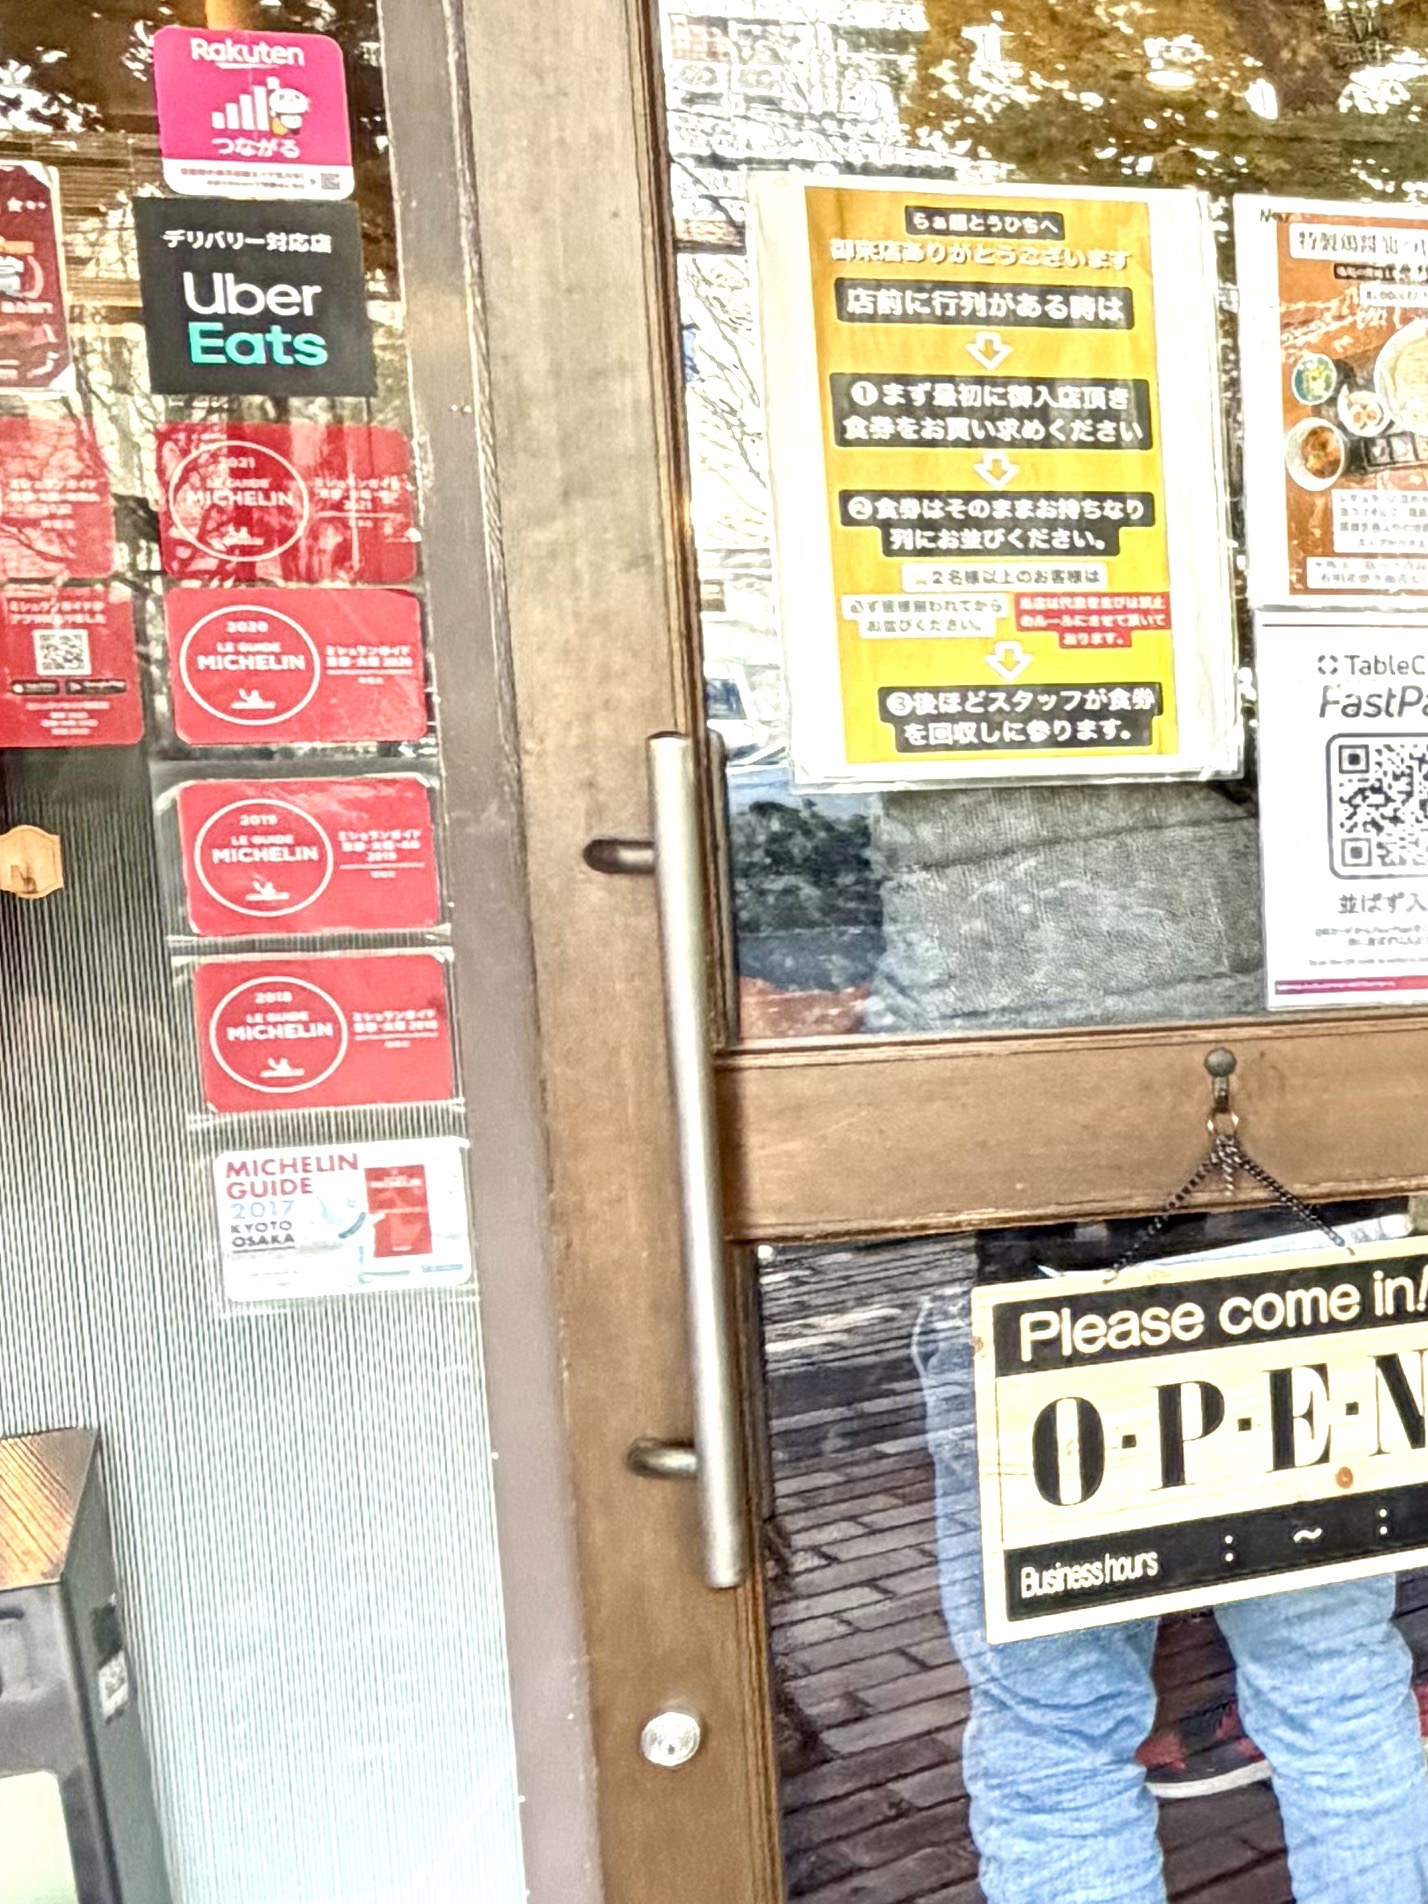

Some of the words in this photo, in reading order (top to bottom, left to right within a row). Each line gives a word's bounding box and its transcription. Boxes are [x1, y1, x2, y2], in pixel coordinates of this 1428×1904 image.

[190, 37, 305, 67] Rakuten
[211, 137, 300, 159] つながる
[162, 228, 332, 254] デリバリー対応店
[183, 271, 322, 317] Uber
[846, 286, 1125, 322] 店前に行列がある時は
[188, 322, 329, 367] Eats
[842, 415, 1145, 442] 食券をお買い求めください
[186, 489, 295, 507] MICHELIN
[889, 525, 1107, 551] 列にお並びください。
[196, 653, 306, 671] MICHELIN
[904, 720, 1132, 746] を回収しに参ります。
[212, 845, 319, 865] MICHELIN
[227, 1022, 334, 1042] MICHELIN
[226, 1153, 359, 1179] MICHELIN
[226, 1177, 313, 1200] GUIDE
[230, 1199, 295, 1220] 2017
[230, 1220, 293, 1234] KYOTO
[232, 1233, 296, 1247] OSAKA
[1019, 1302, 1205, 1363] Please
[1218, 1282, 1361, 1336] come
